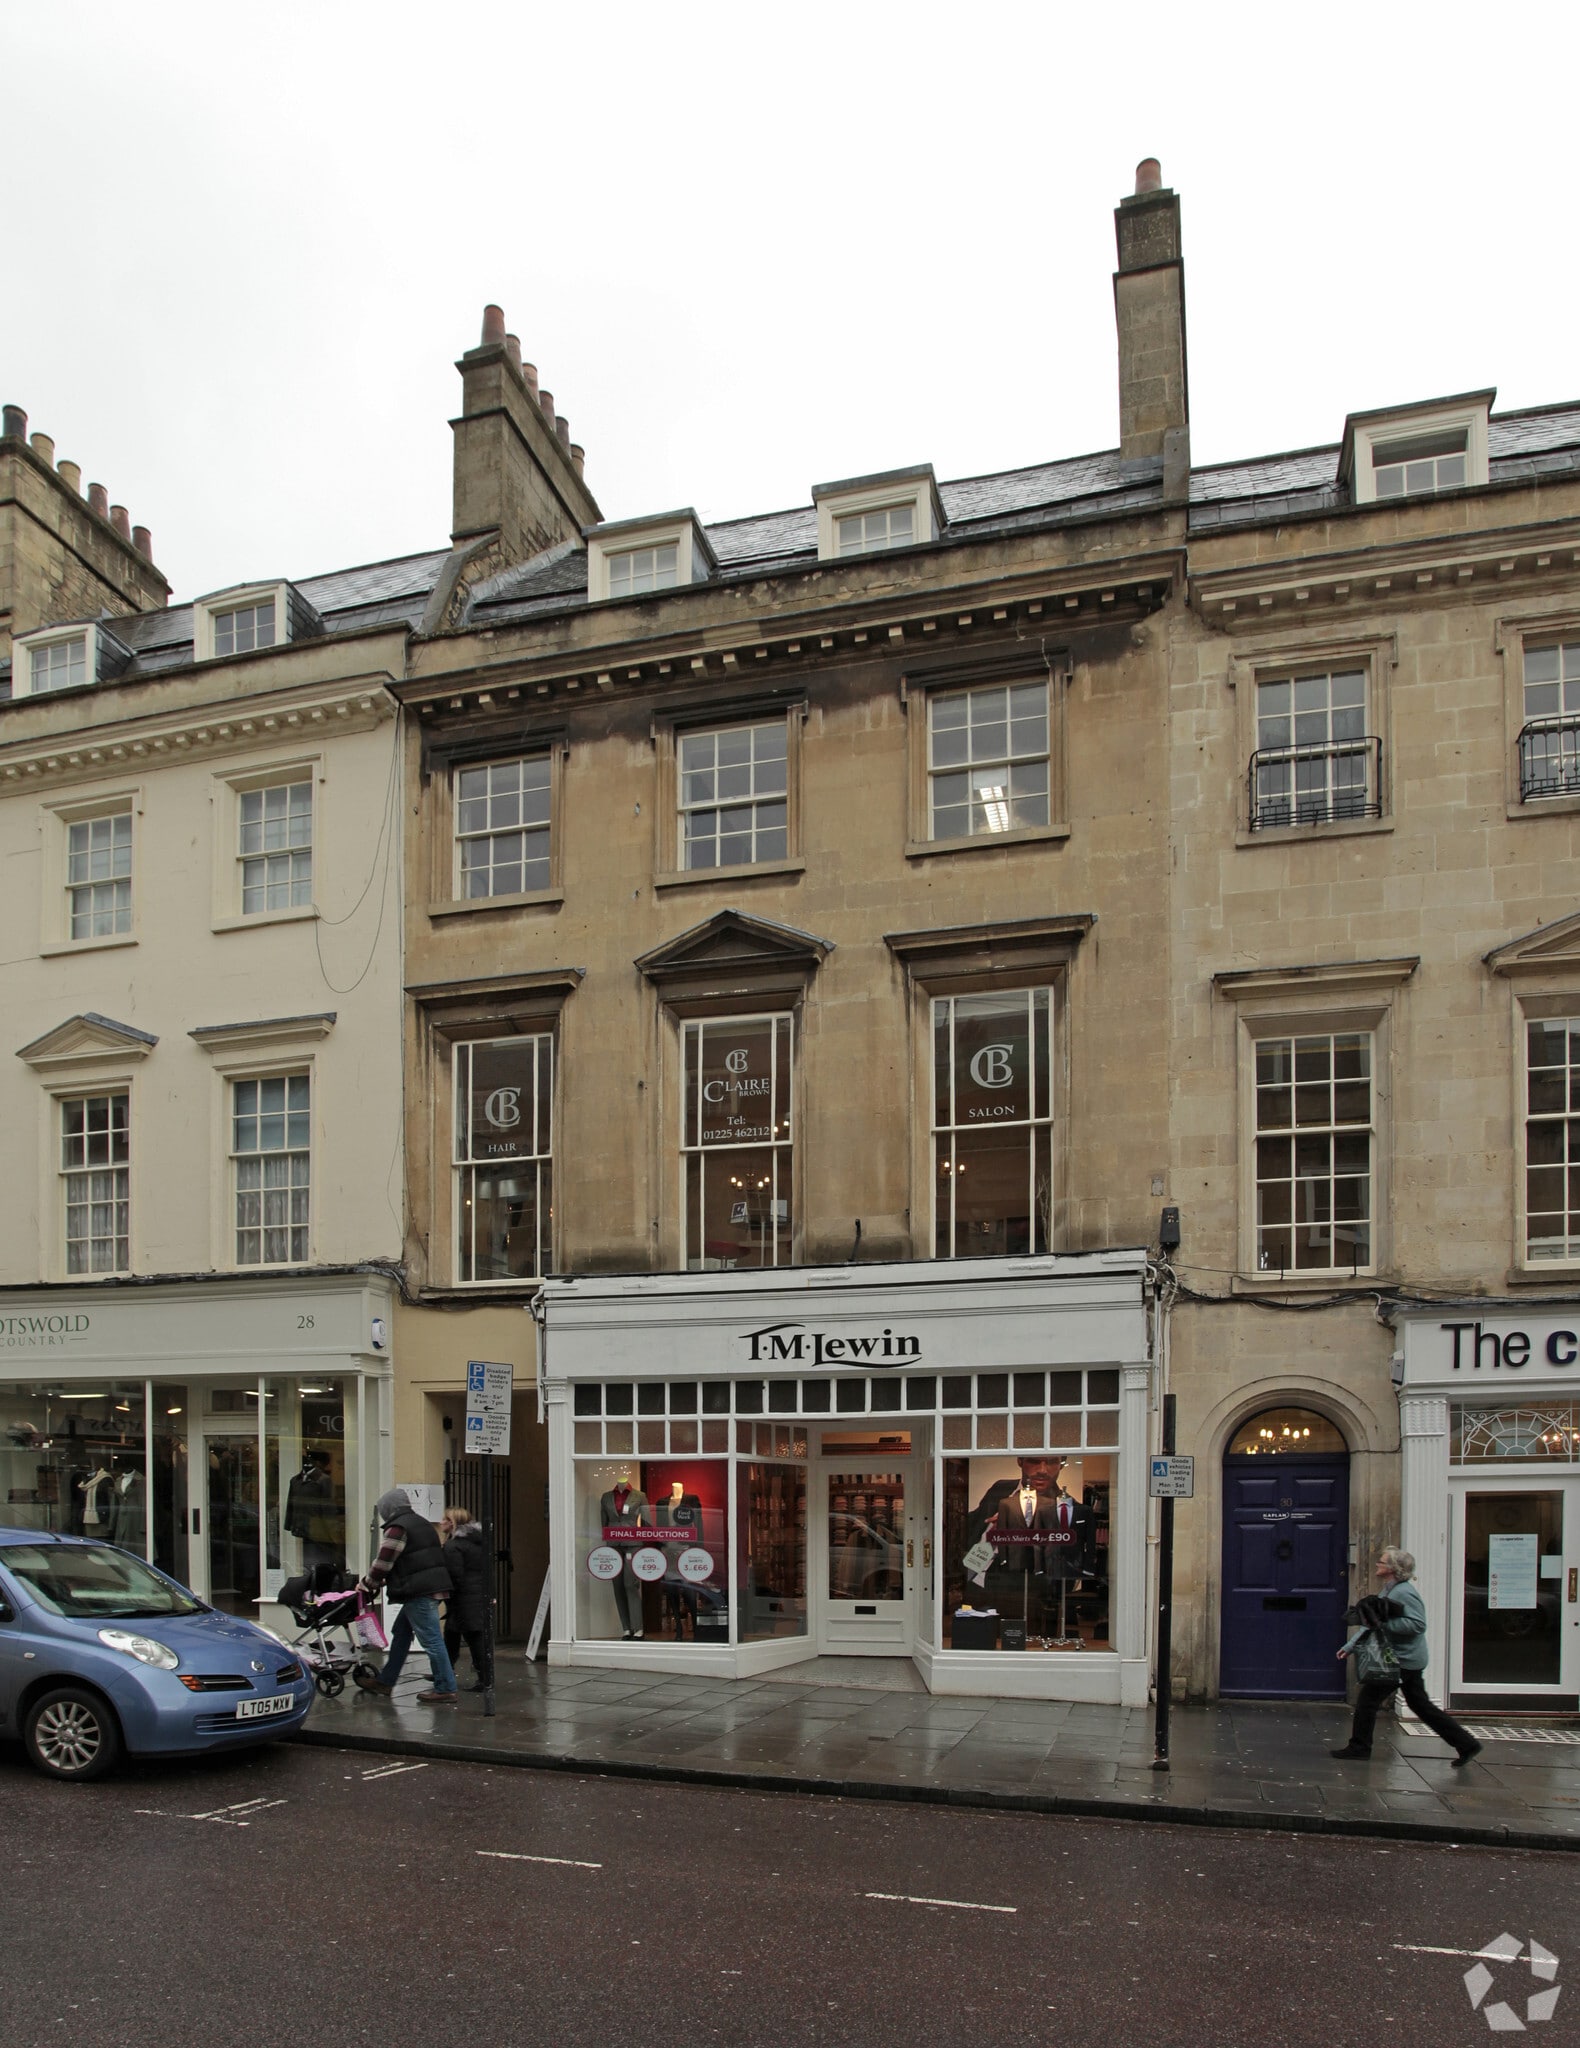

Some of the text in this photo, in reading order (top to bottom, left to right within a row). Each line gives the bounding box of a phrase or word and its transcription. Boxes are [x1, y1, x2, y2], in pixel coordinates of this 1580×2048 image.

[703, 1078, 770, 1103] CLAIRE
[738, 1089, 770, 1097] BROWN
[968, 1105, 1015, 1118] SALON
[727, 1115, 746, 1126] Tel:
[703, 1126, 770, 1140] 01225 462112
[488, 1142, 517, 1153] HAIR
[0, 1314, 90, 1335] TSWOLD
[297, 1315, 315, 1329] 28
[1441, 1322, 1580, 1369] The c
[1032, 1533, 1040, 1541] 4
[1048, 1533, 1071, 1542] £90
[242, 1696, 290, 1716] LT05 MXW
